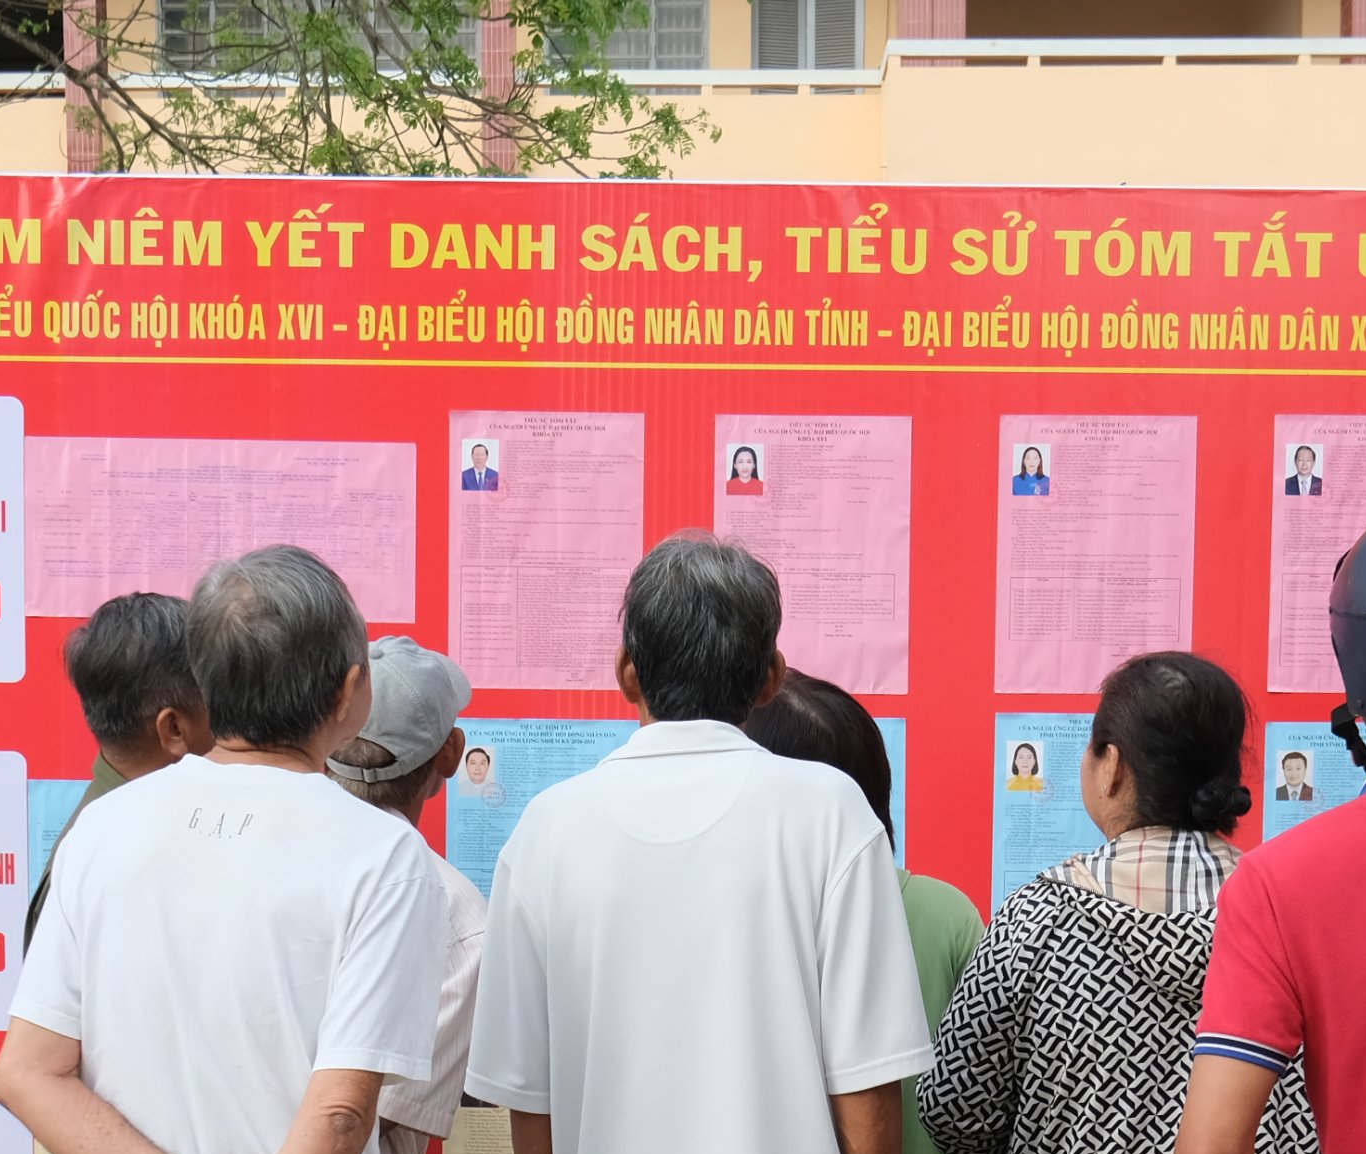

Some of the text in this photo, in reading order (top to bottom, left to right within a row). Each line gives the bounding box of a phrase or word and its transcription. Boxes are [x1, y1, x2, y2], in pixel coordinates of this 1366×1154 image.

[68, 208, 224, 268] NIÊM
[246, 204, 366, 269] YẾT
[391, 223, 557, 272] DANH
[581, 213, 763, 283] SÁCH,
[786, 203, 929, 276] TIỂU
[951, 211, 1038, 277] SỬ
[1054, 218, 1194, 279] TÓM
[1214, 210, 1335, 280] TẮT
[44, 290, 122, 344] QUỐC
[131, 296, 180, 348] HỘI
[190, 295, 268, 342] KHÓA
[278, 304, 325, 342] XVI
[358, 305, 408, 351] ĐẠI
[418, 290, 487, 344] BIỂU
[497, 299, 546, 353] HỘI
[556, 294, 636, 346] ĐỒNG
[645, 301, 725, 346] NHÂN
[734, 301, 795, 347] DÂN
[805, 298, 870, 348] TỈNH
[903, 311, 954, 357] ĐẠI
[963, 296, 1032, 350] BIỂU
[1041, 305, 1091, 358] HỘI
[1101, 300, 1181, 352] ĐỒNG
[1190, 306, 1271, 352] NHÂN
[1280, 307, 1341, 353] DÂN
